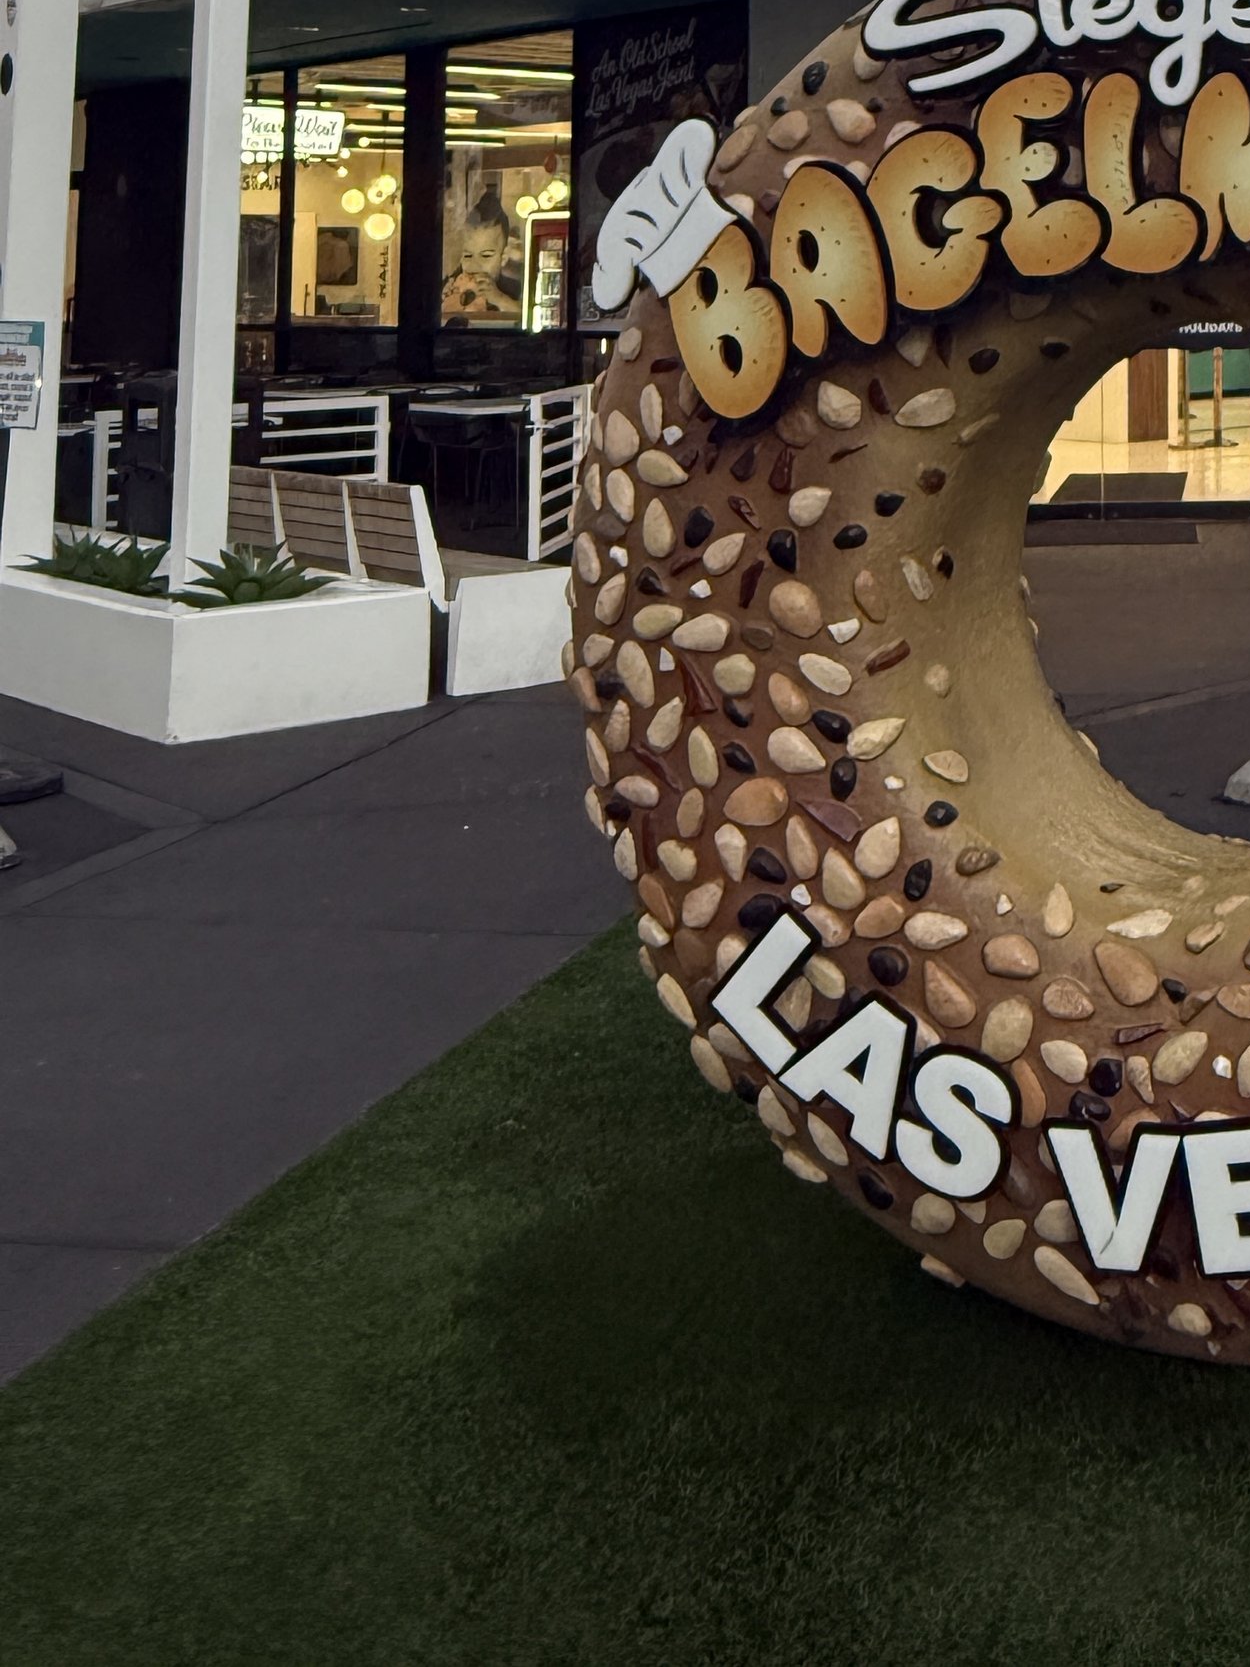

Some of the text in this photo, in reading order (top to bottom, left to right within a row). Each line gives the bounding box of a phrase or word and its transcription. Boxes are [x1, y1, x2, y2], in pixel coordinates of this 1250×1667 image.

[591, 17, 697, 82] An Old School
[585, 55, 695, 117] Las Vegas Joint
[710, 911, 1015, 1200] LAS
